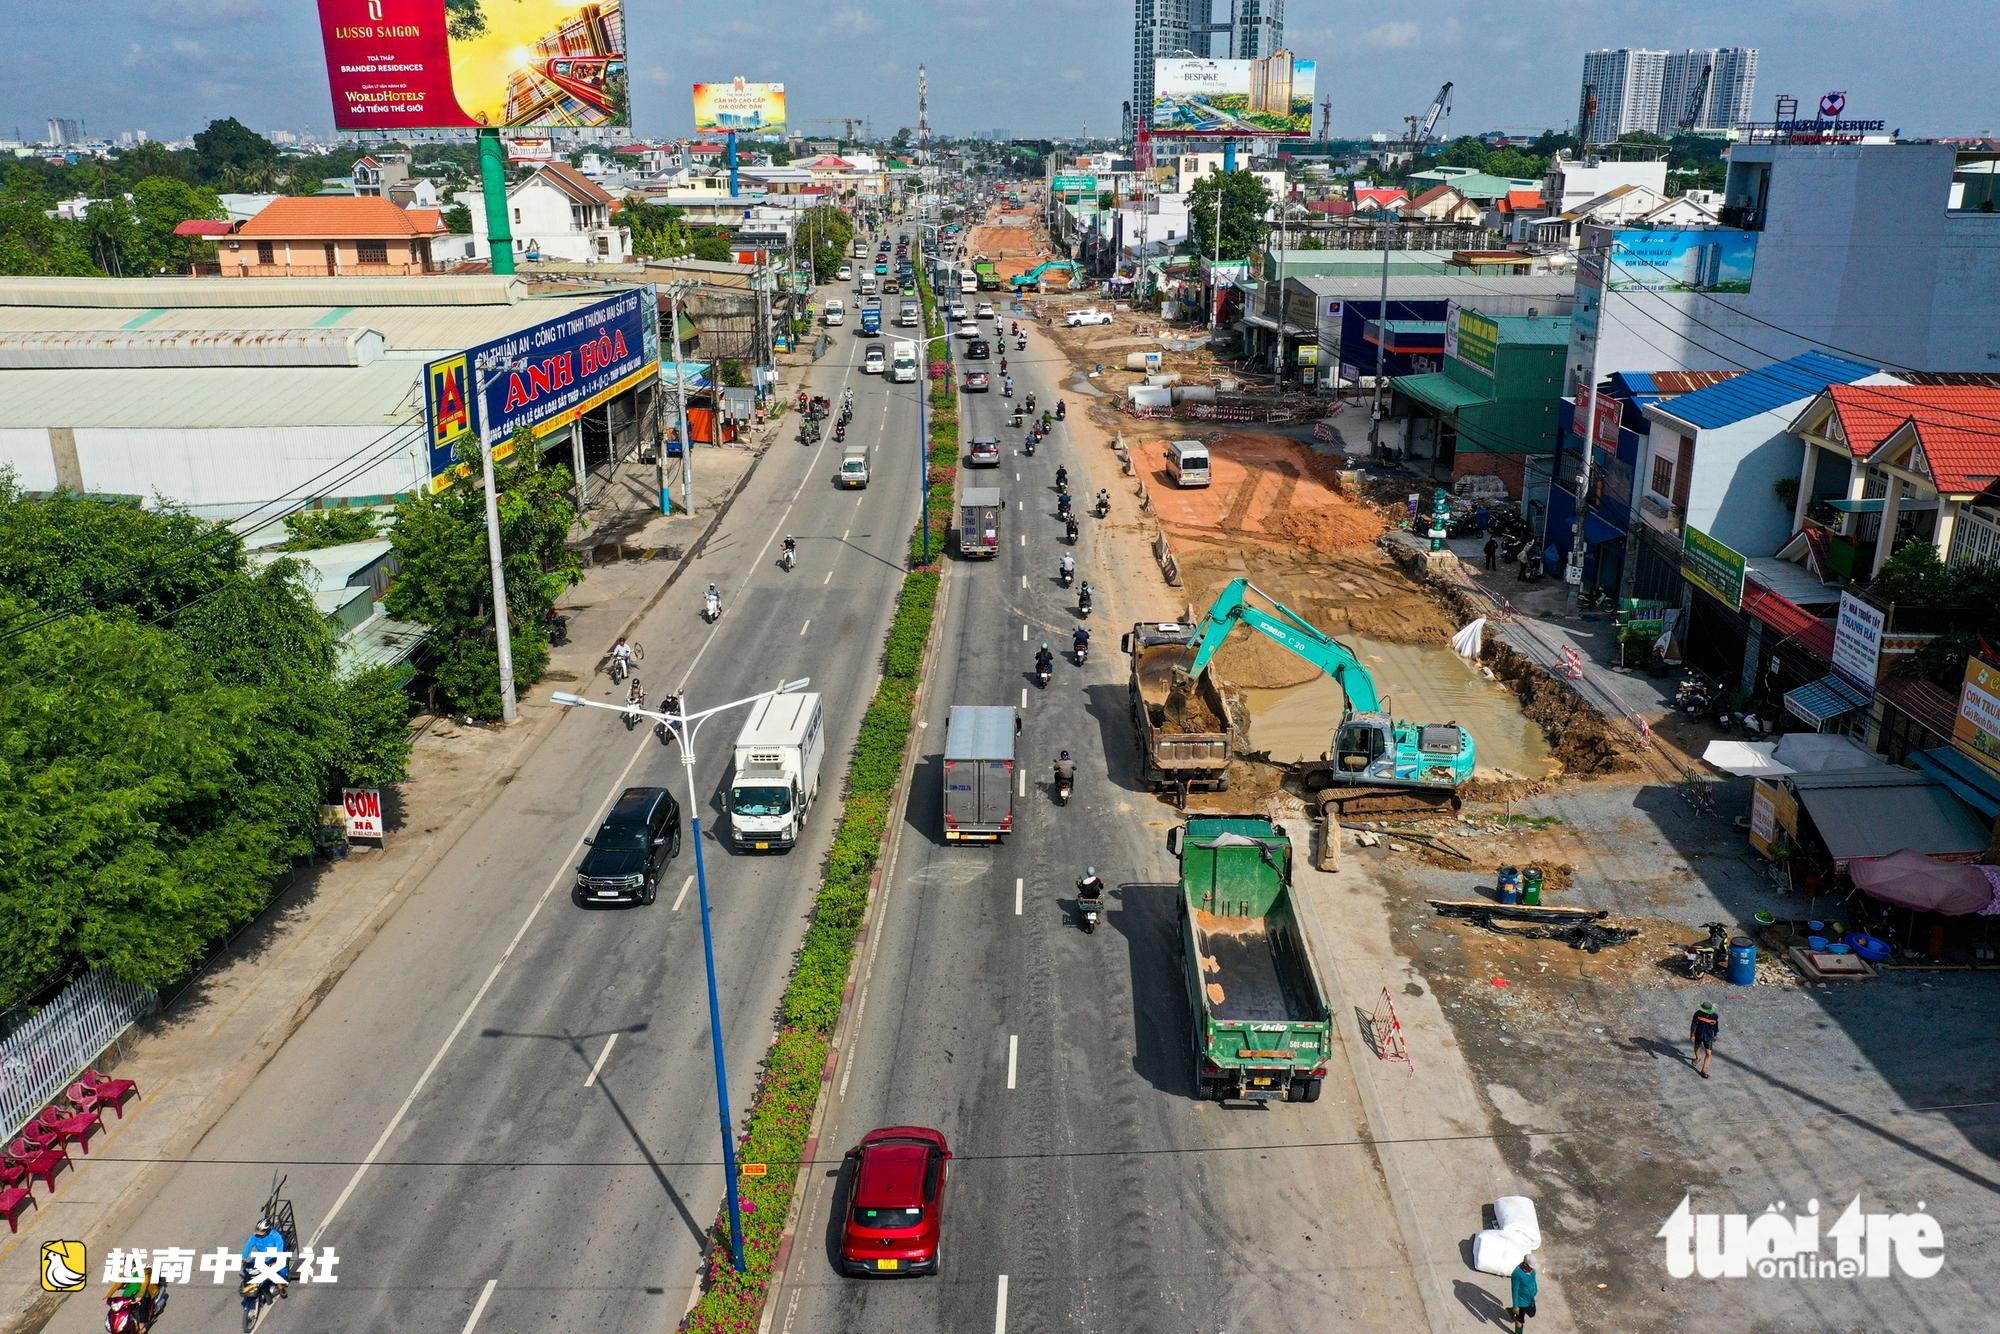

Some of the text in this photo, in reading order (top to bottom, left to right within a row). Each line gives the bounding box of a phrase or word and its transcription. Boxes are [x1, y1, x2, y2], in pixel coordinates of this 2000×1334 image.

[336, 25, 420, 39] LUSSO SAIGON
[341, 64, 424, 73] BRANDED RESIDENCES
[366, 103, 389, 113] TIẾNG
[390, 103, 405, 112] THẾ
[407, 103, 424, 112] GIỚI
[1835, 120, 1885, 131] SERVICE
[518, 336, 530, 354] AN
[535, 327, 557, 348] CÔNG
[556, 323, 566, 340] TY
[567, 319, 584, 336] TNHH
[585, 309, 606, 328] THƯƠNG
[616, 299, 626, 317] SẮT
[626, 295, 638, 312] THÉP
[580, 326, 629, 378] HÒA
[1842, 613, 1864, 636] THANH
[1288, 637, 1295, 645] C
[1294, 641, 1305, 651] 20
[345, 790, 381, 818] CƠM
